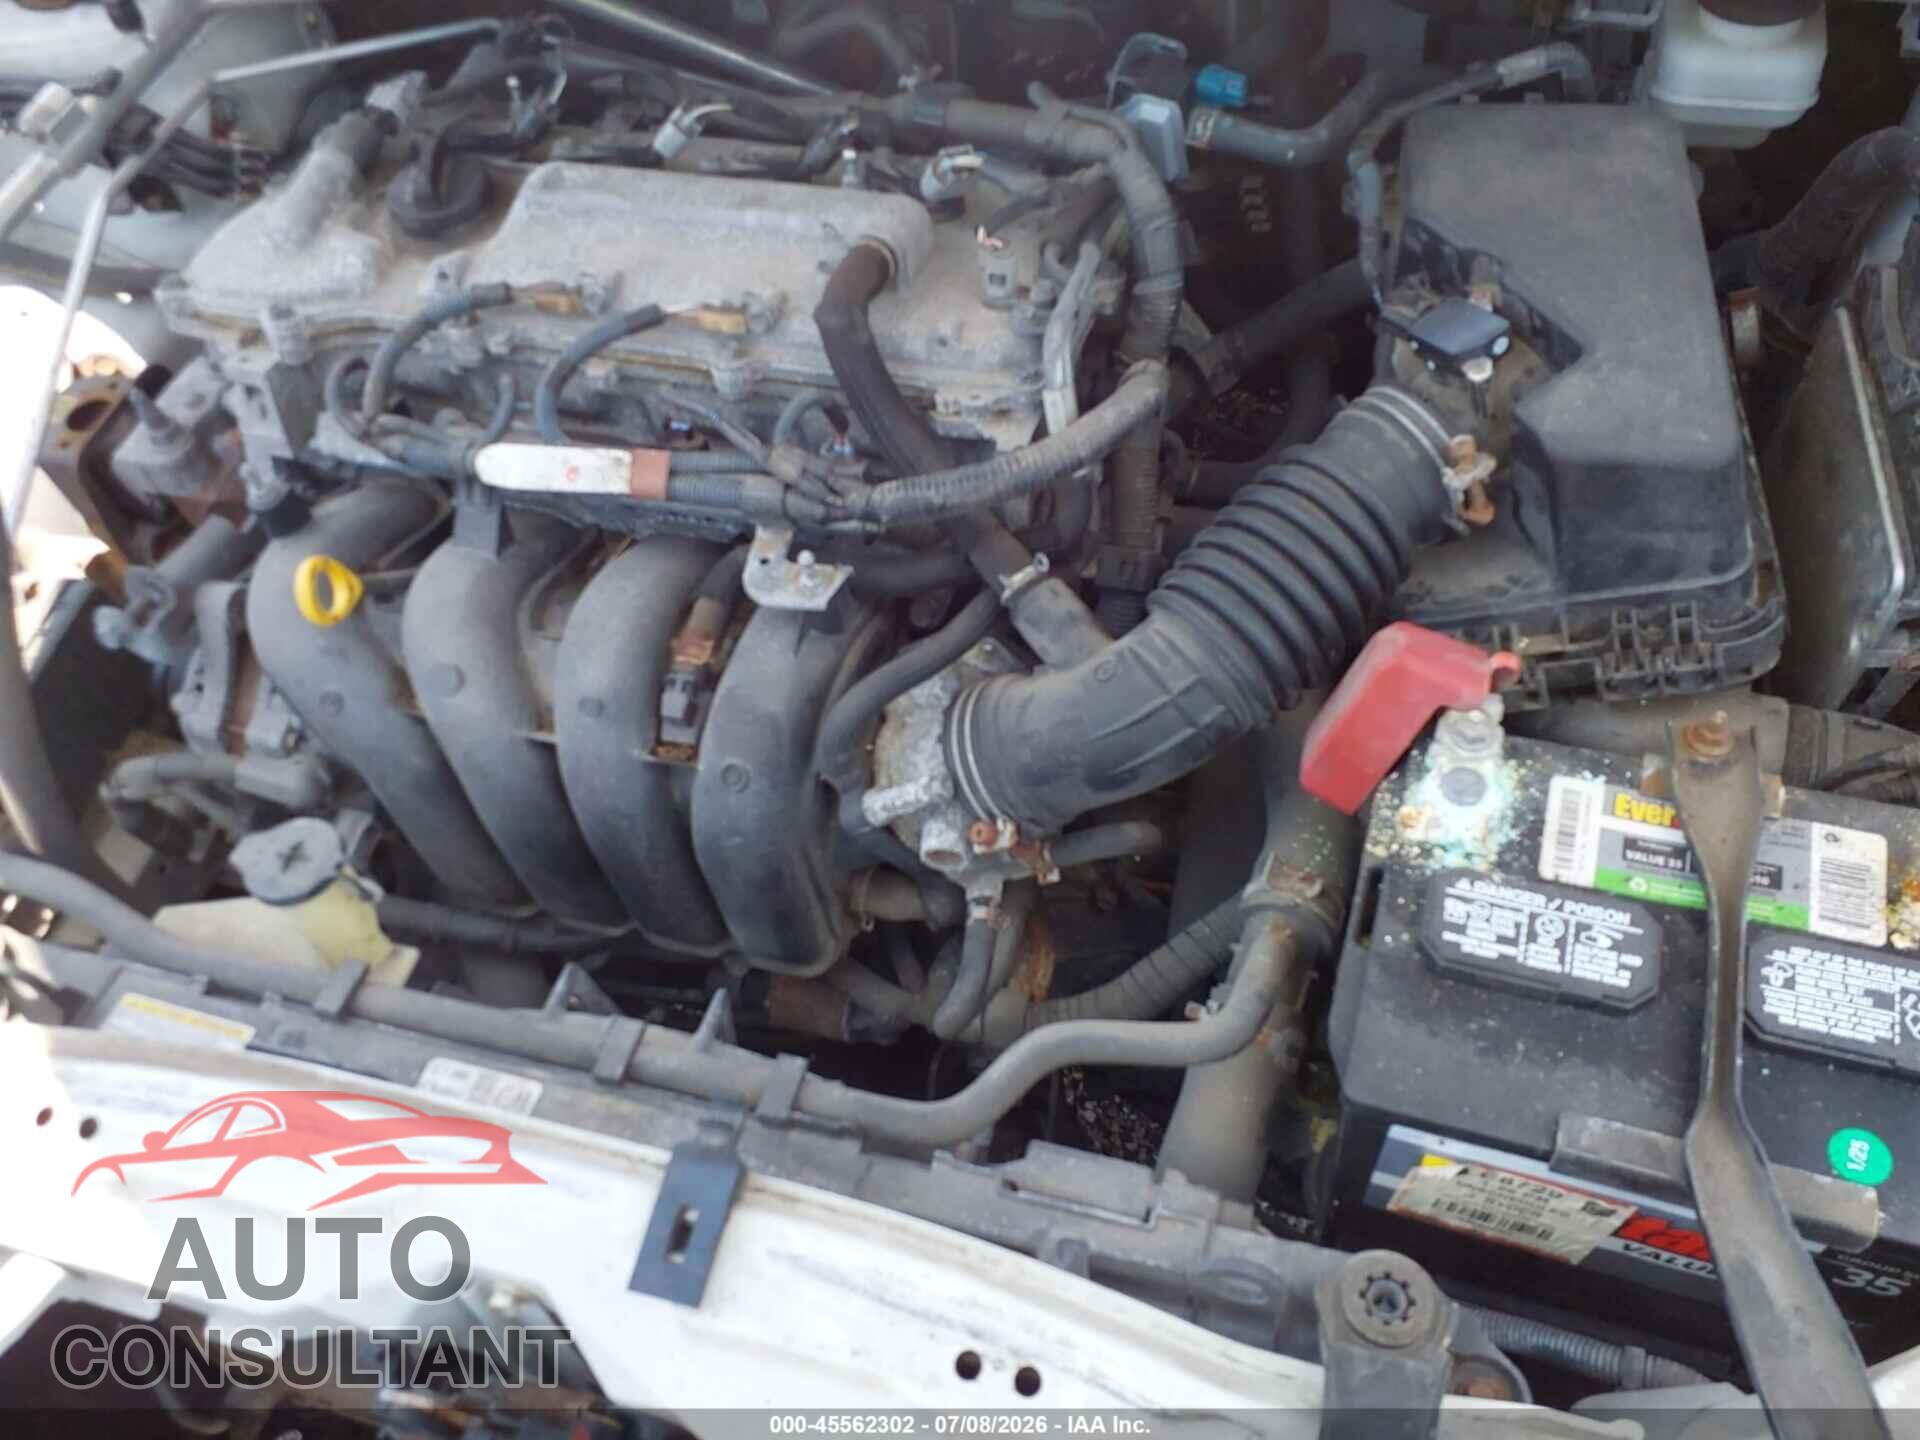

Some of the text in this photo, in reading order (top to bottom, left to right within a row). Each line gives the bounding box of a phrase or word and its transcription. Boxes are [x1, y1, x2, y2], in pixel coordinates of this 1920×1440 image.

[1615, 792, 1680, 829] Ever
[1473, 880, 1546, 907] DANGER
[1563, 900, 1631, 925] POISON
[1832, 1265, 1911, 1296] 35
